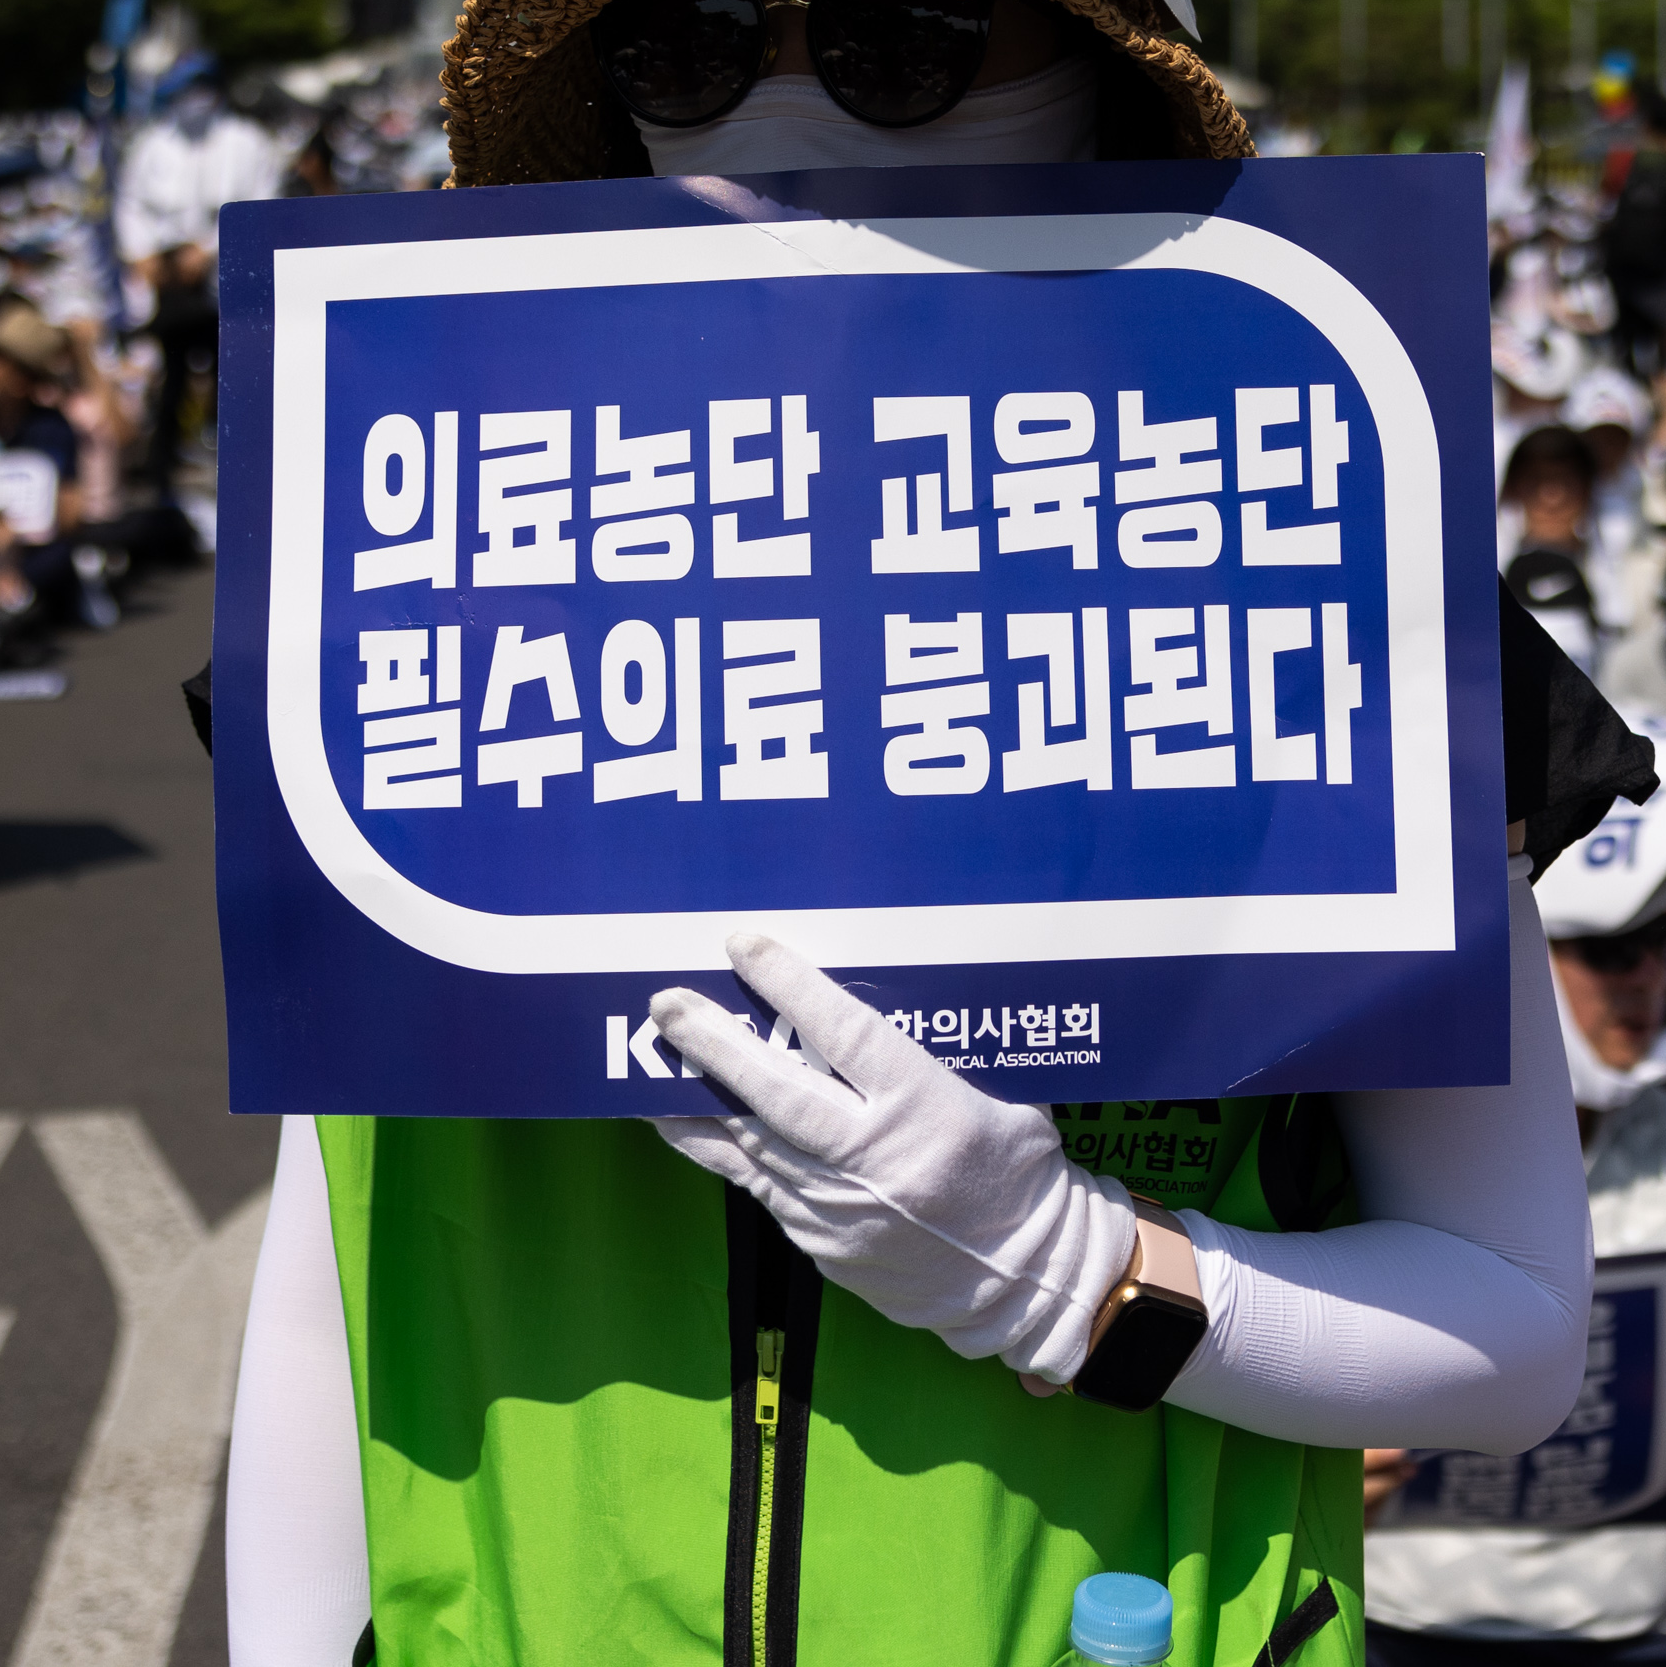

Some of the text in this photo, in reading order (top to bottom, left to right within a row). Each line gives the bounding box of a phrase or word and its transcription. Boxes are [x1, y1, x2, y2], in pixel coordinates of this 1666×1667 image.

[353, 384, 1351, 592] 의료농단 교육농단
[357, 603, 1363, 810] 필수의료 붕괴된다
[885, 1003, 1100, 1050] 한의사협회
[994, 1050, 1101, 1068] ASSOCIATION
[1061, 1130, 1218, 1174] 의사협회
